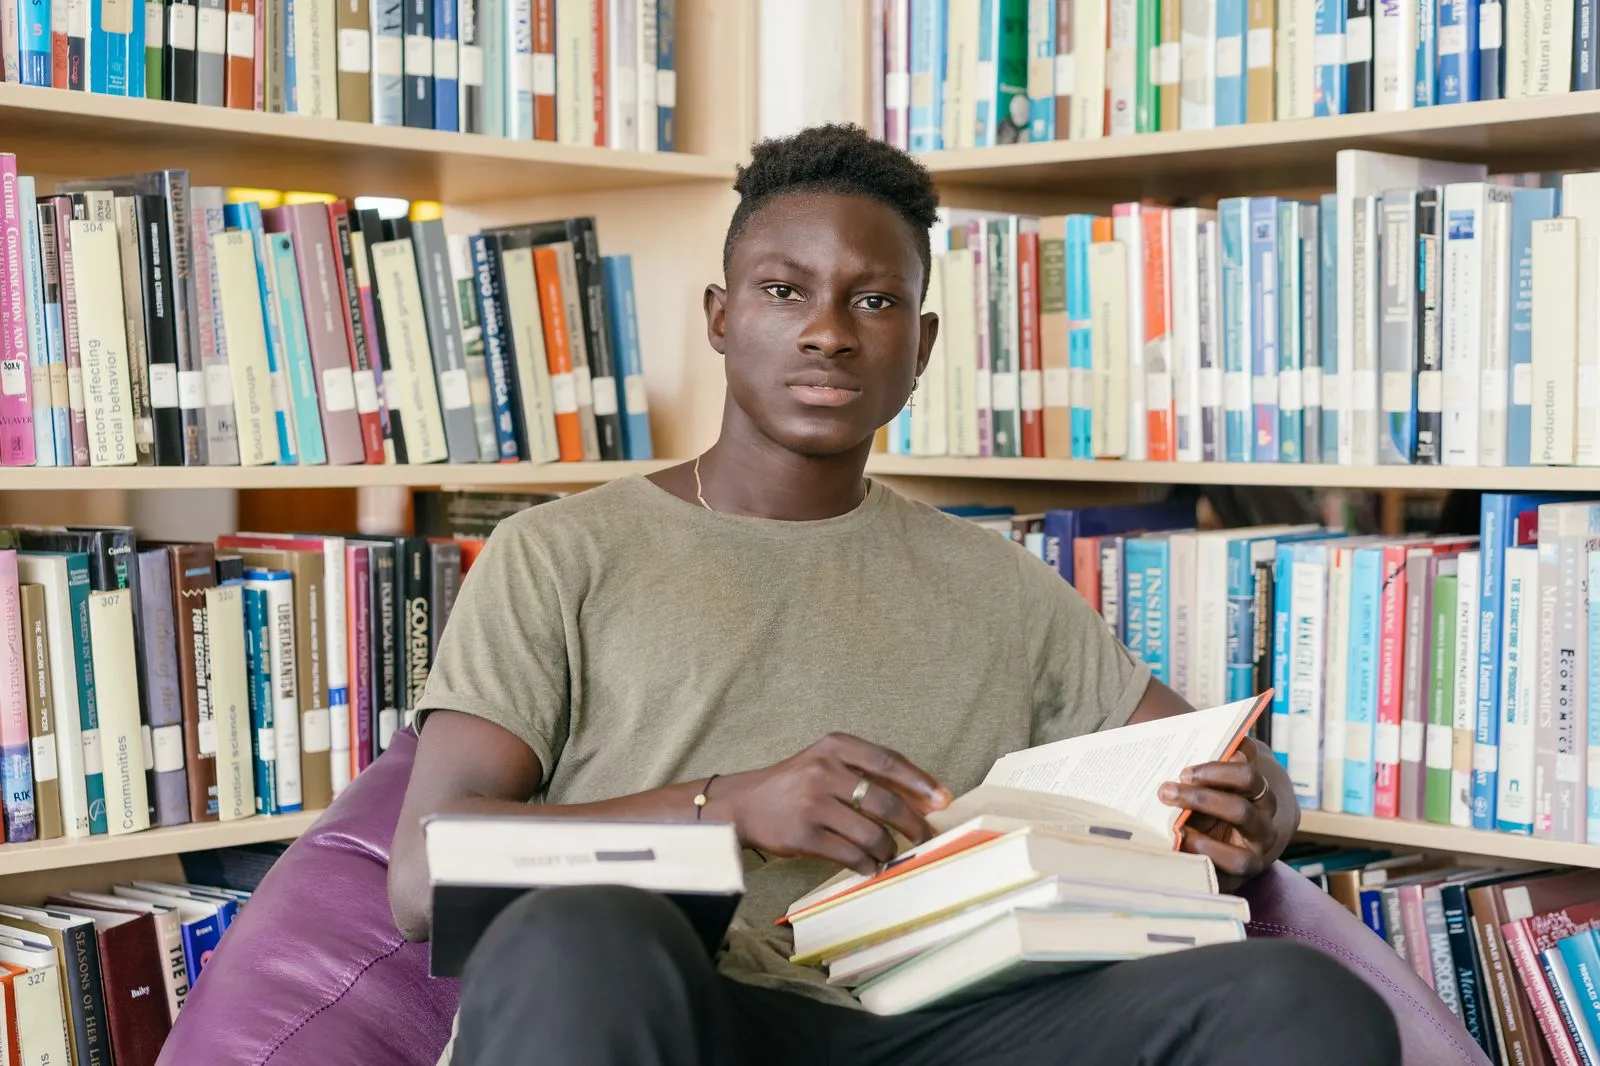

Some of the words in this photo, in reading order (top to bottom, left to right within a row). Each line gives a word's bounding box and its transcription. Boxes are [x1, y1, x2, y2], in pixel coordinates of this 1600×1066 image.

[1538, 41, 1551, 92] Natural
[311, 74, 321, 116] Social
[2, 172, 16, 222] CULTURE,
[83, 223, 104, 233] 304
[6, 226, 24, 318] COMMUNICATION
[13, 325, 24, 348] AND
[475, 238, 488, 263] WE
[486, 335, 508, 405] AMERICA
[88, 339, 102, 388] affecting
[107, 349, 121, 412] behavior
[245, 365, 259, 415] groups
[90, 392, 108, 463] Factors
[110, 417, 126, 461] social
[250, 417, 263, 460] Social
[1542, 380, 1555, 461] Production
[115, 561, 128, 589] The
[5, 584, 16, 640] MARRIED
[101, 595, 120, 607] 307
[1146, 567, 1163, 653] INSIDE
[278, 603, 295, 699] LIBERTARIANISM
[1537, 584, 1557, 728] MICROECONOMICS
[1506, 665, 1517, 724] PRODUCTION
[1559, 646, 1574, 753] ECONOMICS
[229, 704, 239, 758] science
[117, 735, 134, 830] Communities
[232, 760, 243, 817] Political
[28, 972, 46, 986] 327
[74, 931, 91, 990] SEASONS
[169, 943, 185, 979] THE
[82, 994, 93, 1010] OF
[130, 986, 150, 999] Bailey
[85, 1016, 97, 1043] HER
